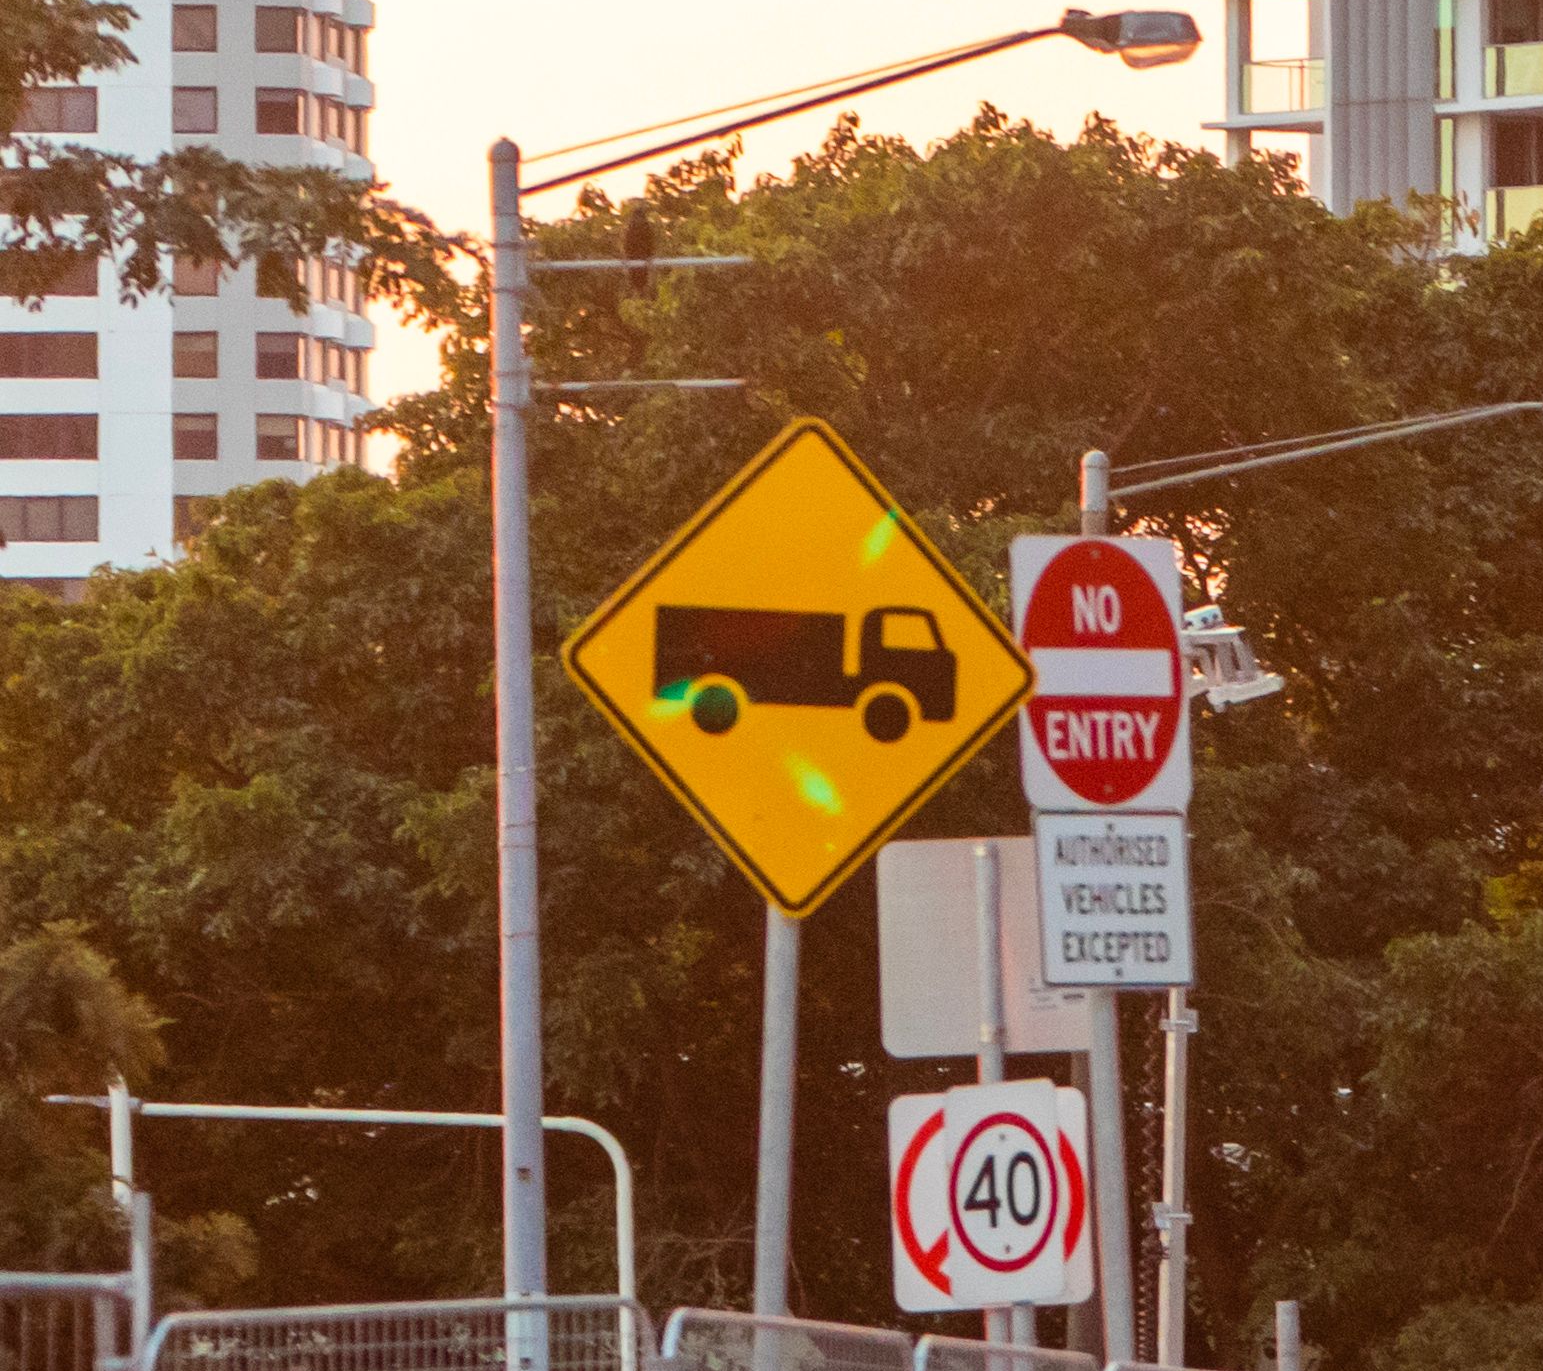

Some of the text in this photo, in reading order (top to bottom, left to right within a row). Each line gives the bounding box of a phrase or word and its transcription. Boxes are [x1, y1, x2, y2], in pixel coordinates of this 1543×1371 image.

[1071, 584, 1123, 635] NO
[1045, 710, 1161, 761] ENTRY
[1055, 834, 1169, 867] AUTHORISED
[1061, 883, 1168, 915] VEHICLES
[1062, 931, 1170, 963] EXCEPTED
[963, 1151, 1041, 1229] 40
